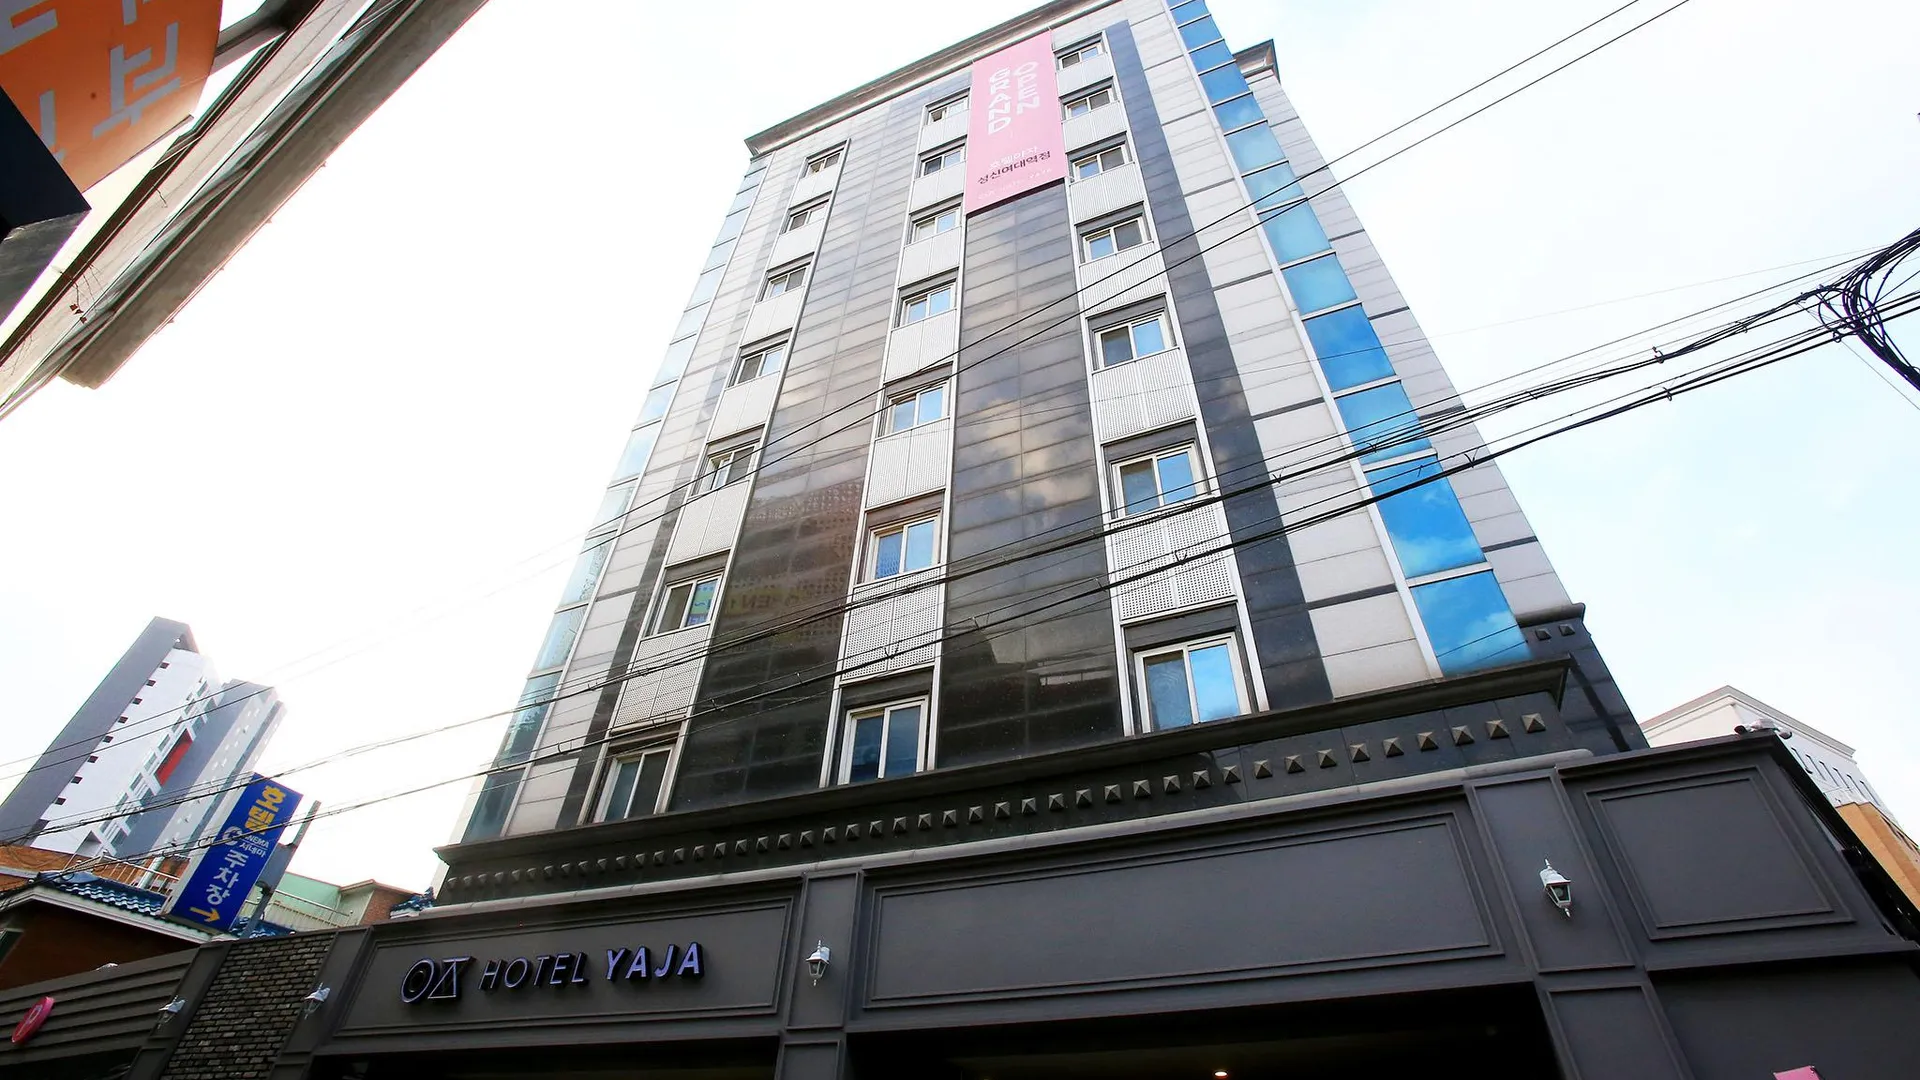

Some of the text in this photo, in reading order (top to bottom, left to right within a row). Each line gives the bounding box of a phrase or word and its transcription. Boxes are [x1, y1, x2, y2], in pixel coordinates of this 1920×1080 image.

[988, 66, 1011, 135] GRAND
[1013, 61, 1039, 114] OPEN
[245, 785, 285, 835] 호텔
[240, 842, 266, 858] 시네마
[206, 850, 249, 905] 주차장
[478, 952, 588, 990] HOTEL
[605, 942, 703, 980] YAJA
